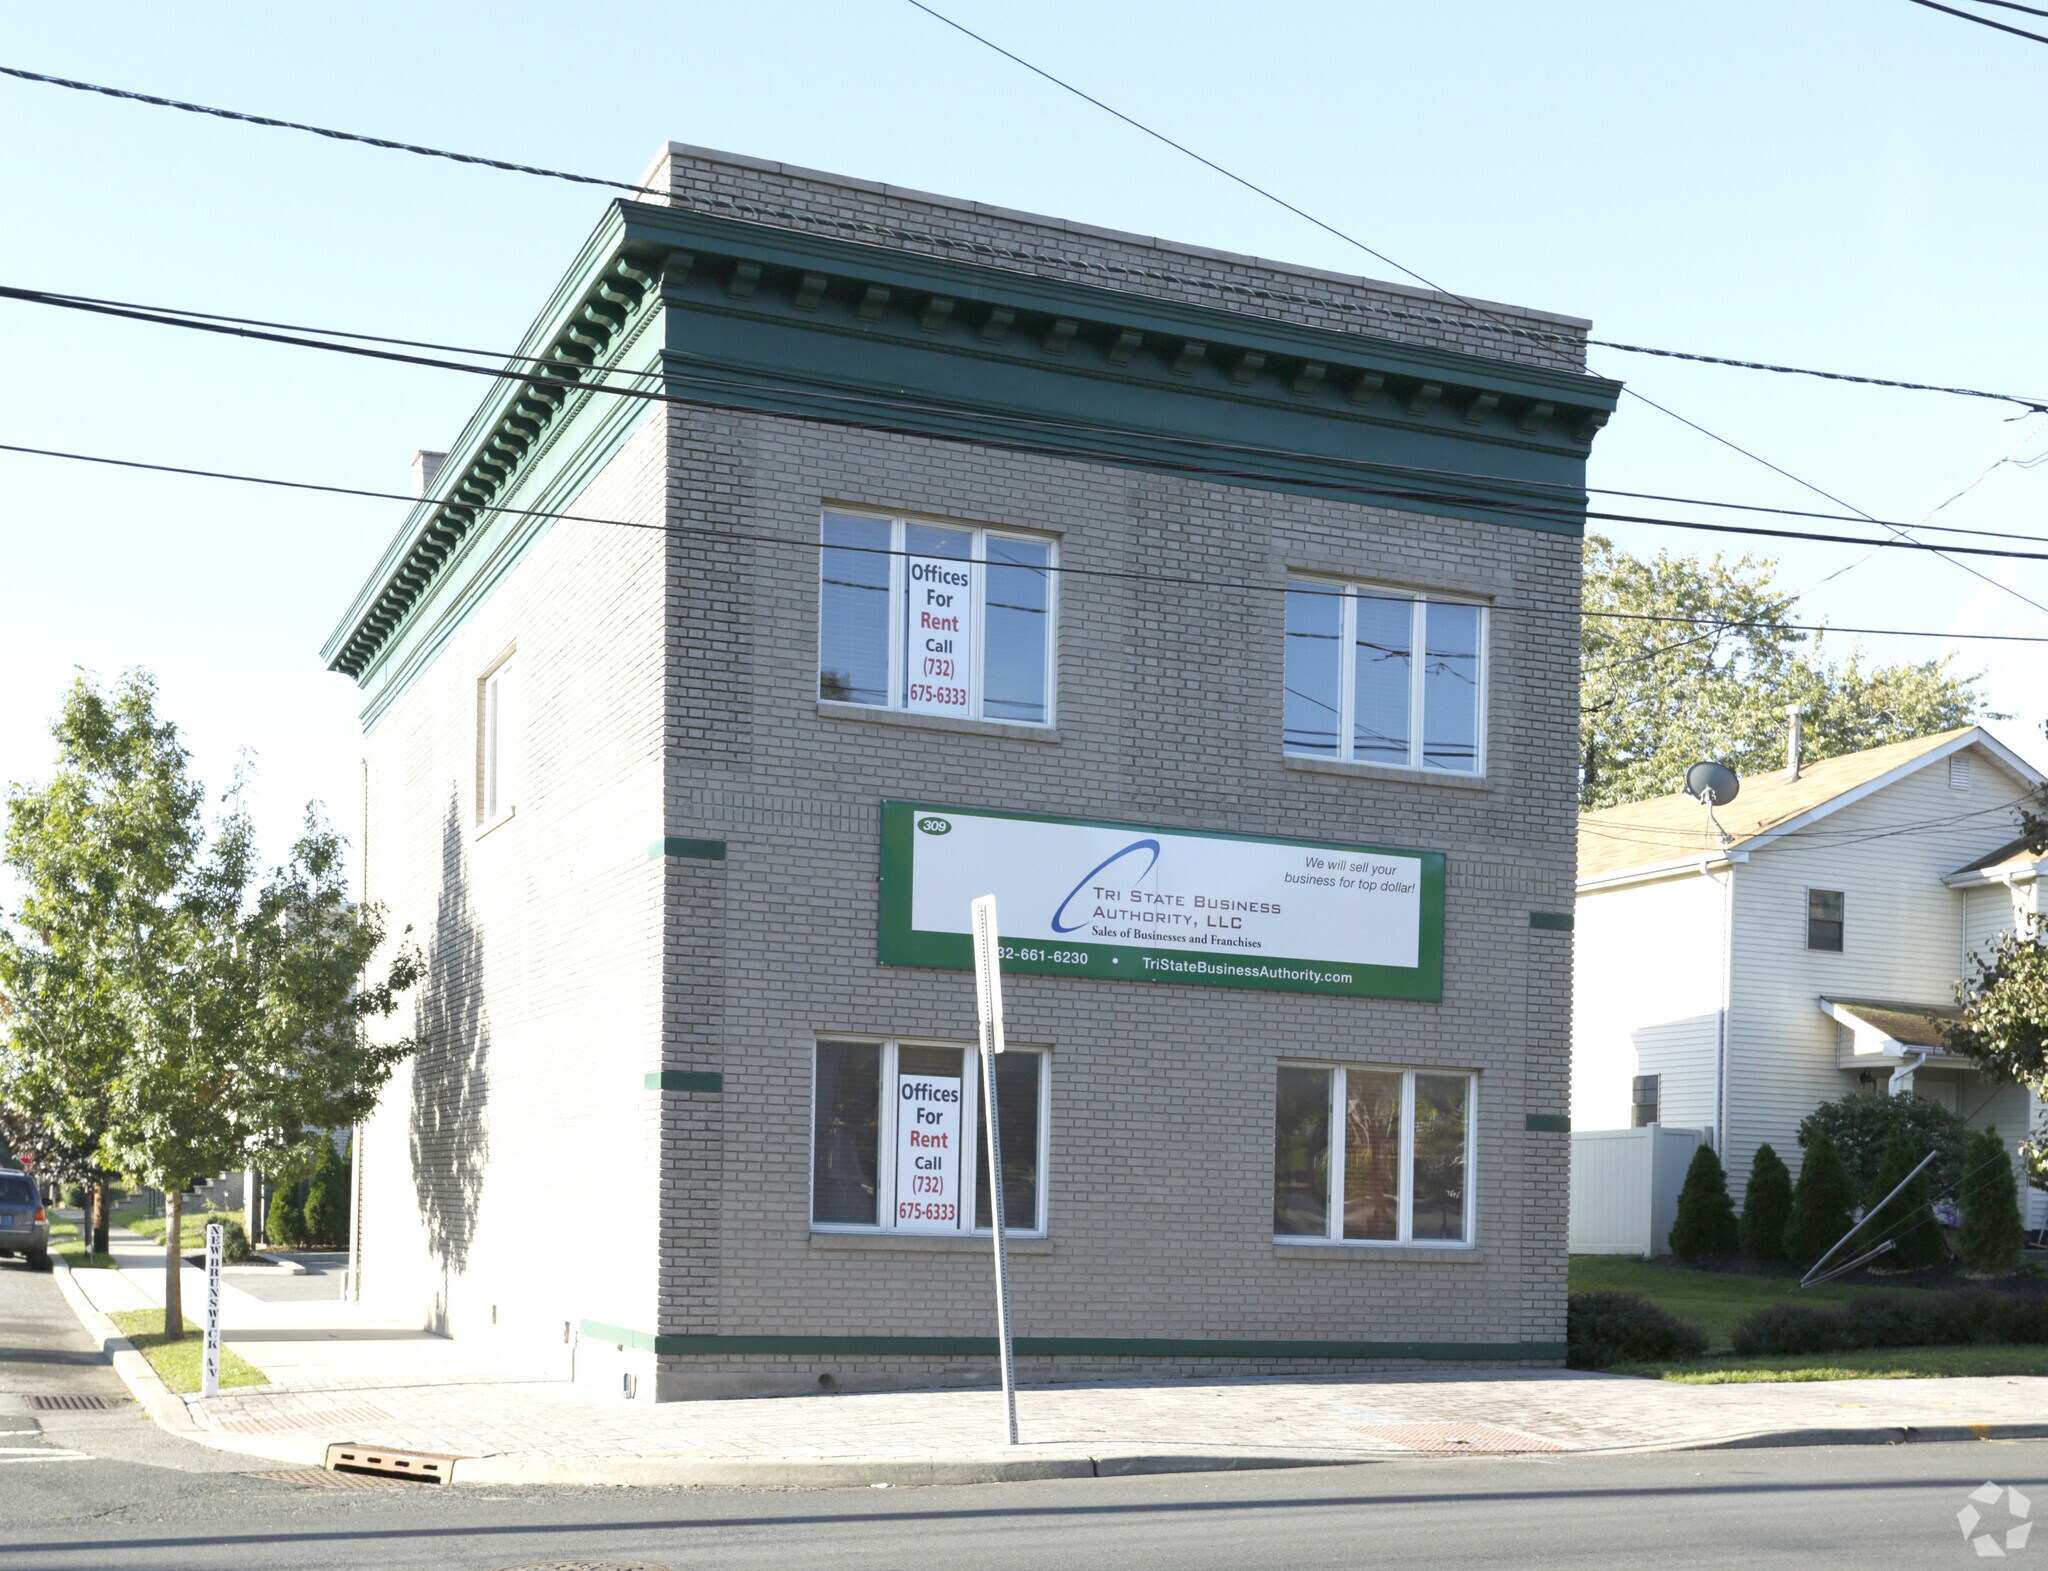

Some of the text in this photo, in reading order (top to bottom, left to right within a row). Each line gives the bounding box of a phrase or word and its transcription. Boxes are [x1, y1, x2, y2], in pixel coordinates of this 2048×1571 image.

[911, 563, 968, 587] Offices
[927, 588, 953, 608] For
[921, 611, 958, 632] Rent
[925, 638, 953, 654] Call
[923, 656, 955, 680] (732)
[910, 683, 966, 706] 675-6333
[922, 819, 947, 832] 309
[1305, 856, 1397, 876] We will sell your
[1284, 872, 1416, 894] business for top dollar!
[1093, 886, 1281, 915] TRI STATE BUSINESS
[1092, 905, 1242, 930] AUTHORITY, LLC
[1091, 925, 1262, 949] Sales of Businesses and Franchises
[998, 946, 1353, 984] 32-661-6230 TriStateBusinessAuthority.com
[901, 1083, 958, 1103] Offices
[916, 1107, 943, 1125] For
[910, 1130, 948, 1148] Rent
[915, 1156, 942, 1170] Call
[912, 1174, 943, 1196] (732)
[899, 1202, 955, 1221] 675-6333
[206, 1226, 221, 1377] NEW BRUNSWICK AV
